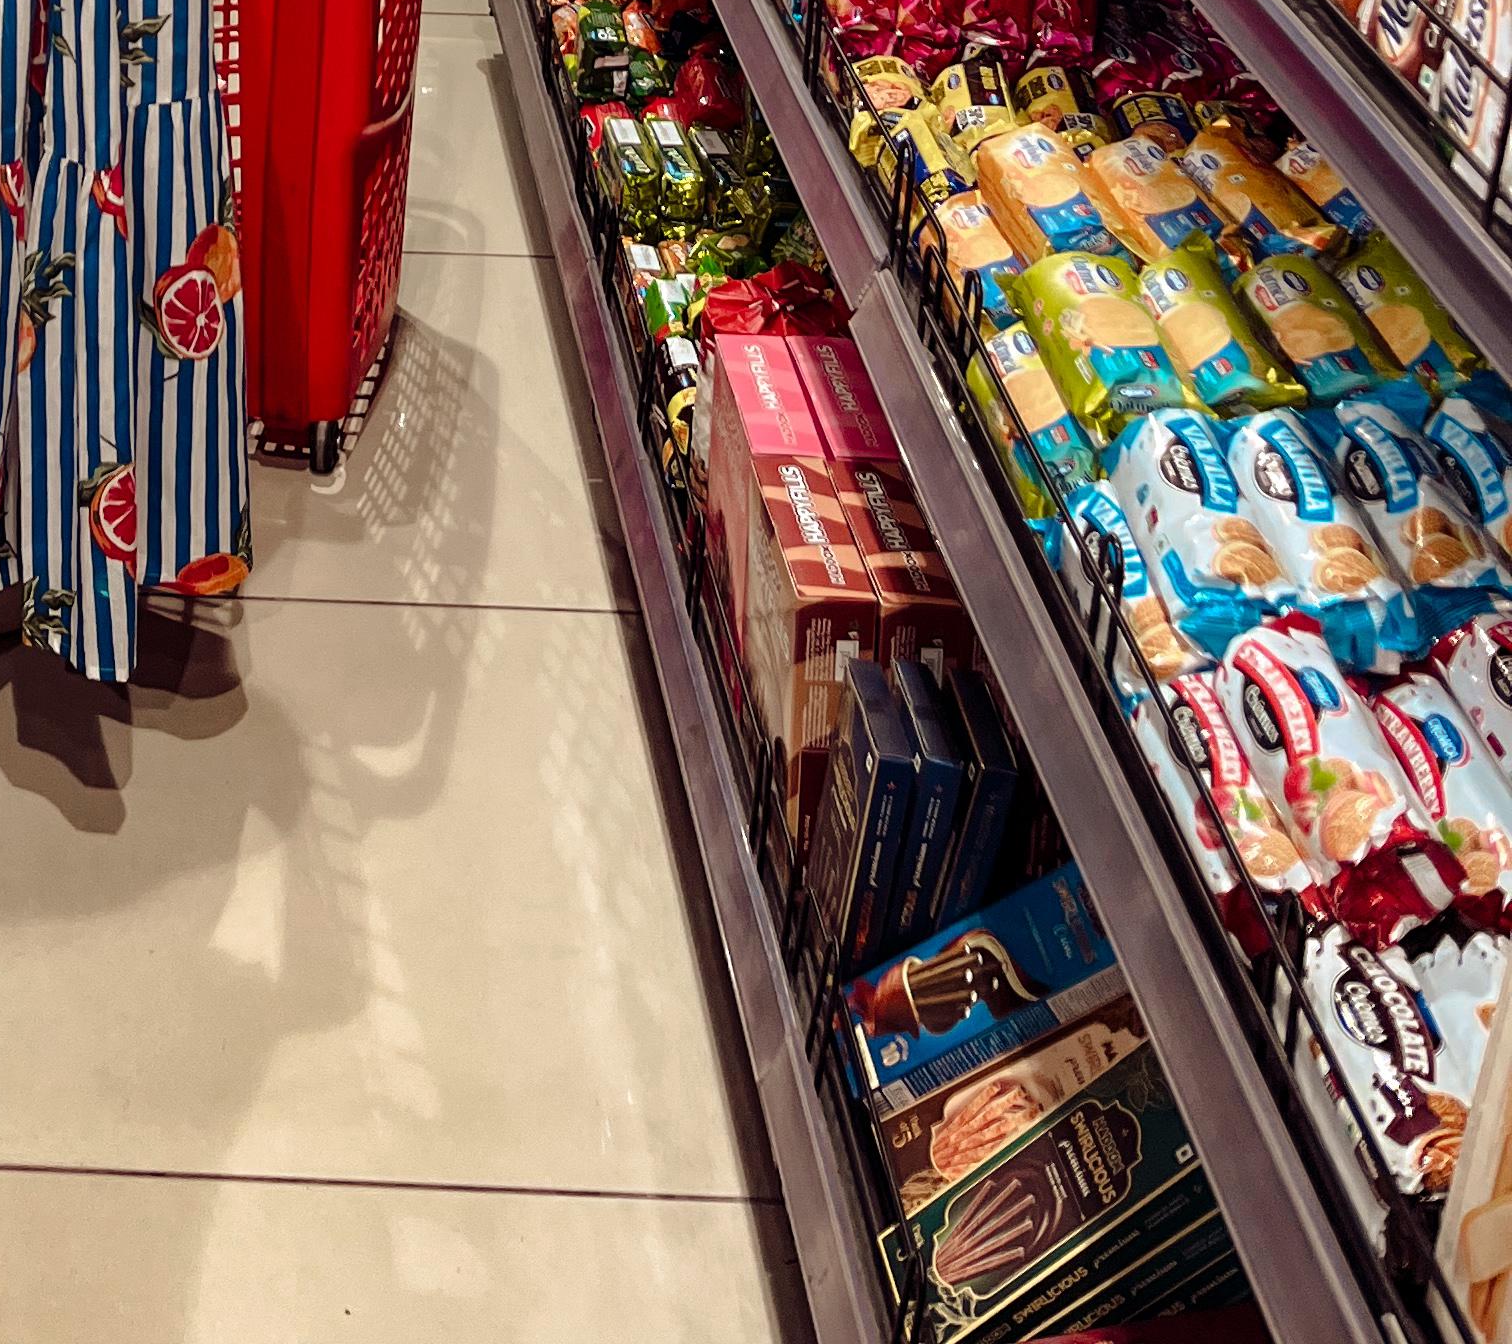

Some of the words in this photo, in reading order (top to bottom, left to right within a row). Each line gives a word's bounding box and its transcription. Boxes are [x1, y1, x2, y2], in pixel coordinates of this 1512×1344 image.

[1271, 427, 1333, 513] VANILLA
[1350, 945, 1430, 1075] CHOCOLATE
[1058, 1139, 1091, 1199] premium
[1069, 1111, 1117, 1205] SWIRLICIOUS
[1011, 1265, 1090, 1325] SWIRLICIOUS
